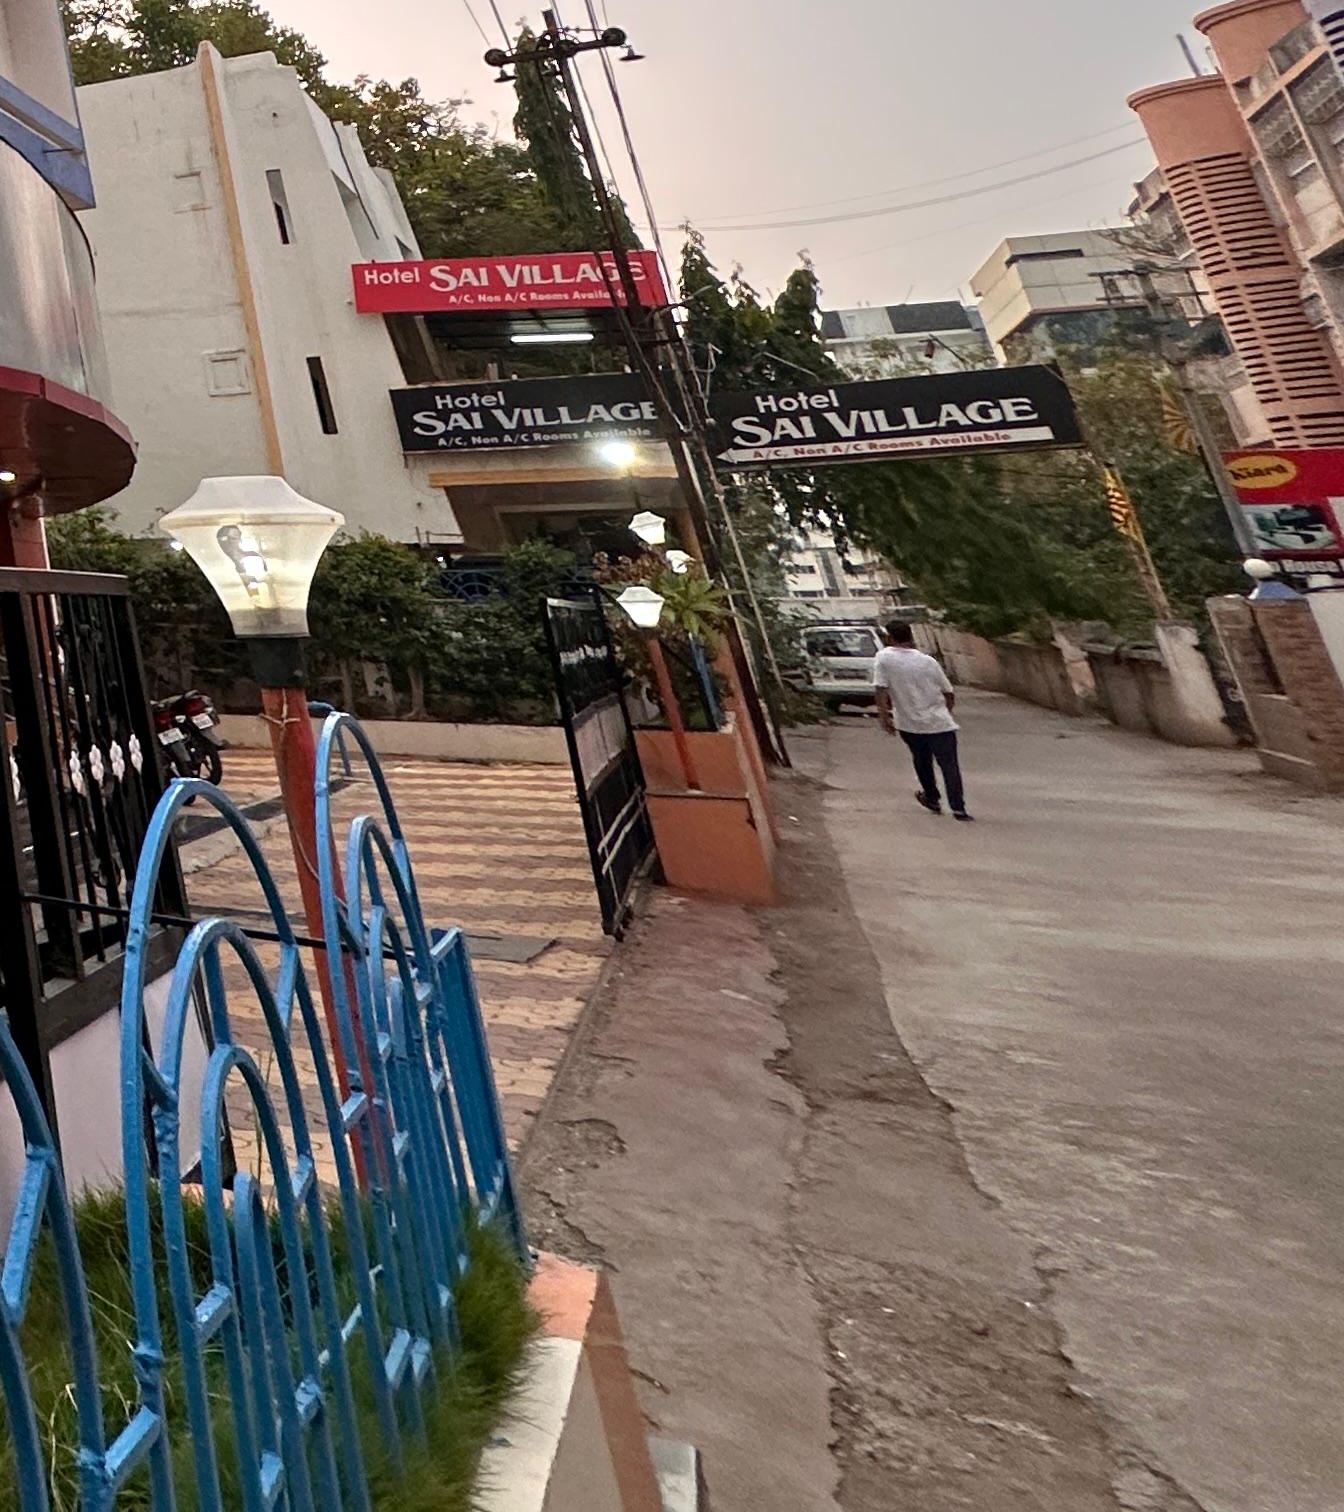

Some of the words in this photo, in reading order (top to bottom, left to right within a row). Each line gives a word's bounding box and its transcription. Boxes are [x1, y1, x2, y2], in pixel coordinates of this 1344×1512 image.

[363, 267, 421, 285] Hotel
[429, 265, 490, 292] SAI
[505, 292, 527, 303] A/C
[530, 291, 570, 301] Rooms
[434, 391, 506, 410] Hotel
[755, 389, 839, 413] Hotel
[413, 410, 485, 436] SAI
[492, 401, 659, 430] VILLAGE
[732, 415, 817, 447] SAI
[825, 397, 1039, 438] VILLAGE
[472, 435, 499, 445] Non
[503, 433, 530, 445] A/C
[533, 432, 579, 442] Rooms
[793, 447, 826, 456] Non
[832, 443, 863, 454] A/C
[868, 440, 923, 451] Rooms
[930, 432, 1011, 446] Available
